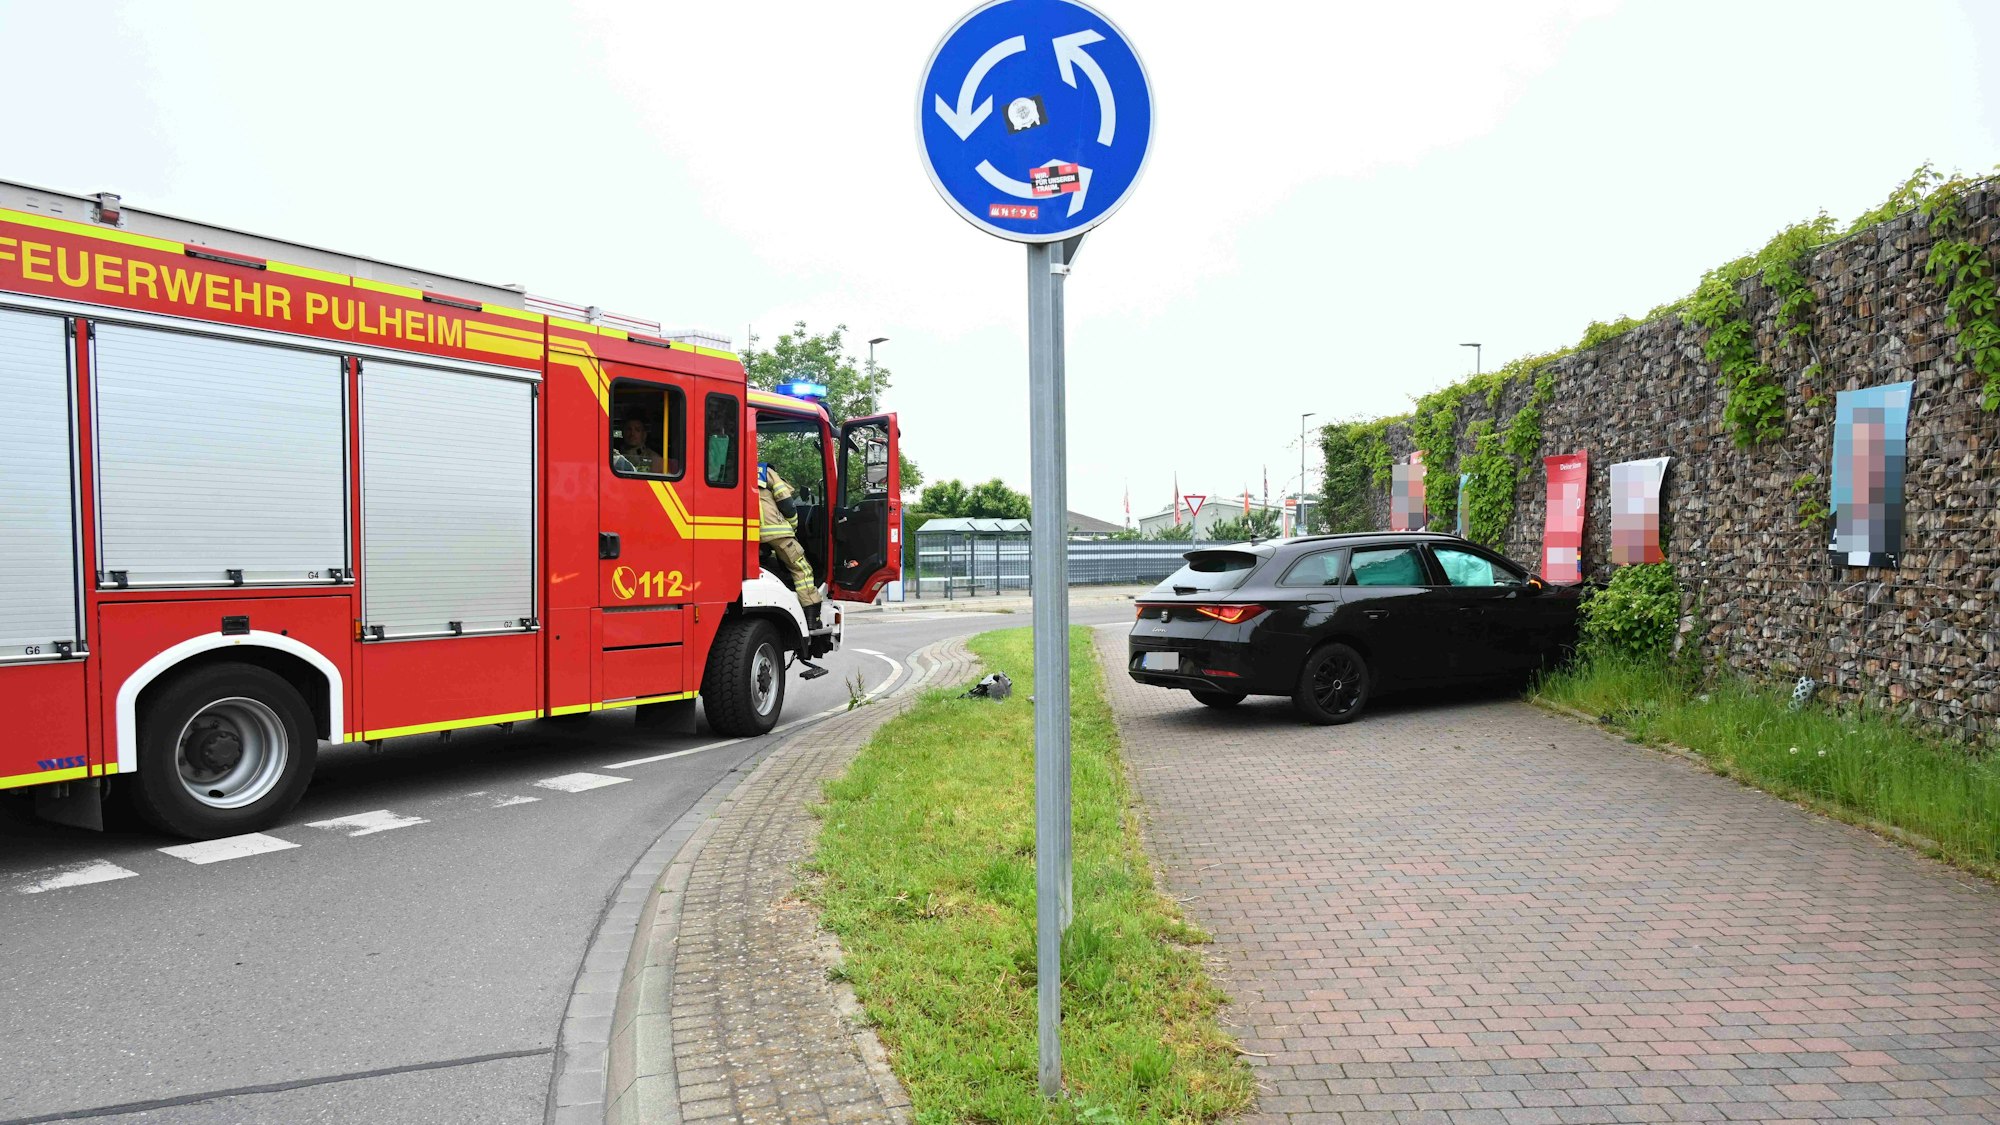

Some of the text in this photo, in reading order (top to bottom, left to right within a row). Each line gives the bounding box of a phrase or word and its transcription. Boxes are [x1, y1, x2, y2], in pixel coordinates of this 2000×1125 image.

[1048, 175, 1075, 184] UNSEREN
[0, 236, 463, 348] FEUERWEHR PULHEIM
[308, 571, 319, 579] G4
[638, 570, 683, 598] 112
[25, 645, 41, 656] G6
[37, 755, 86, 770] WISS
